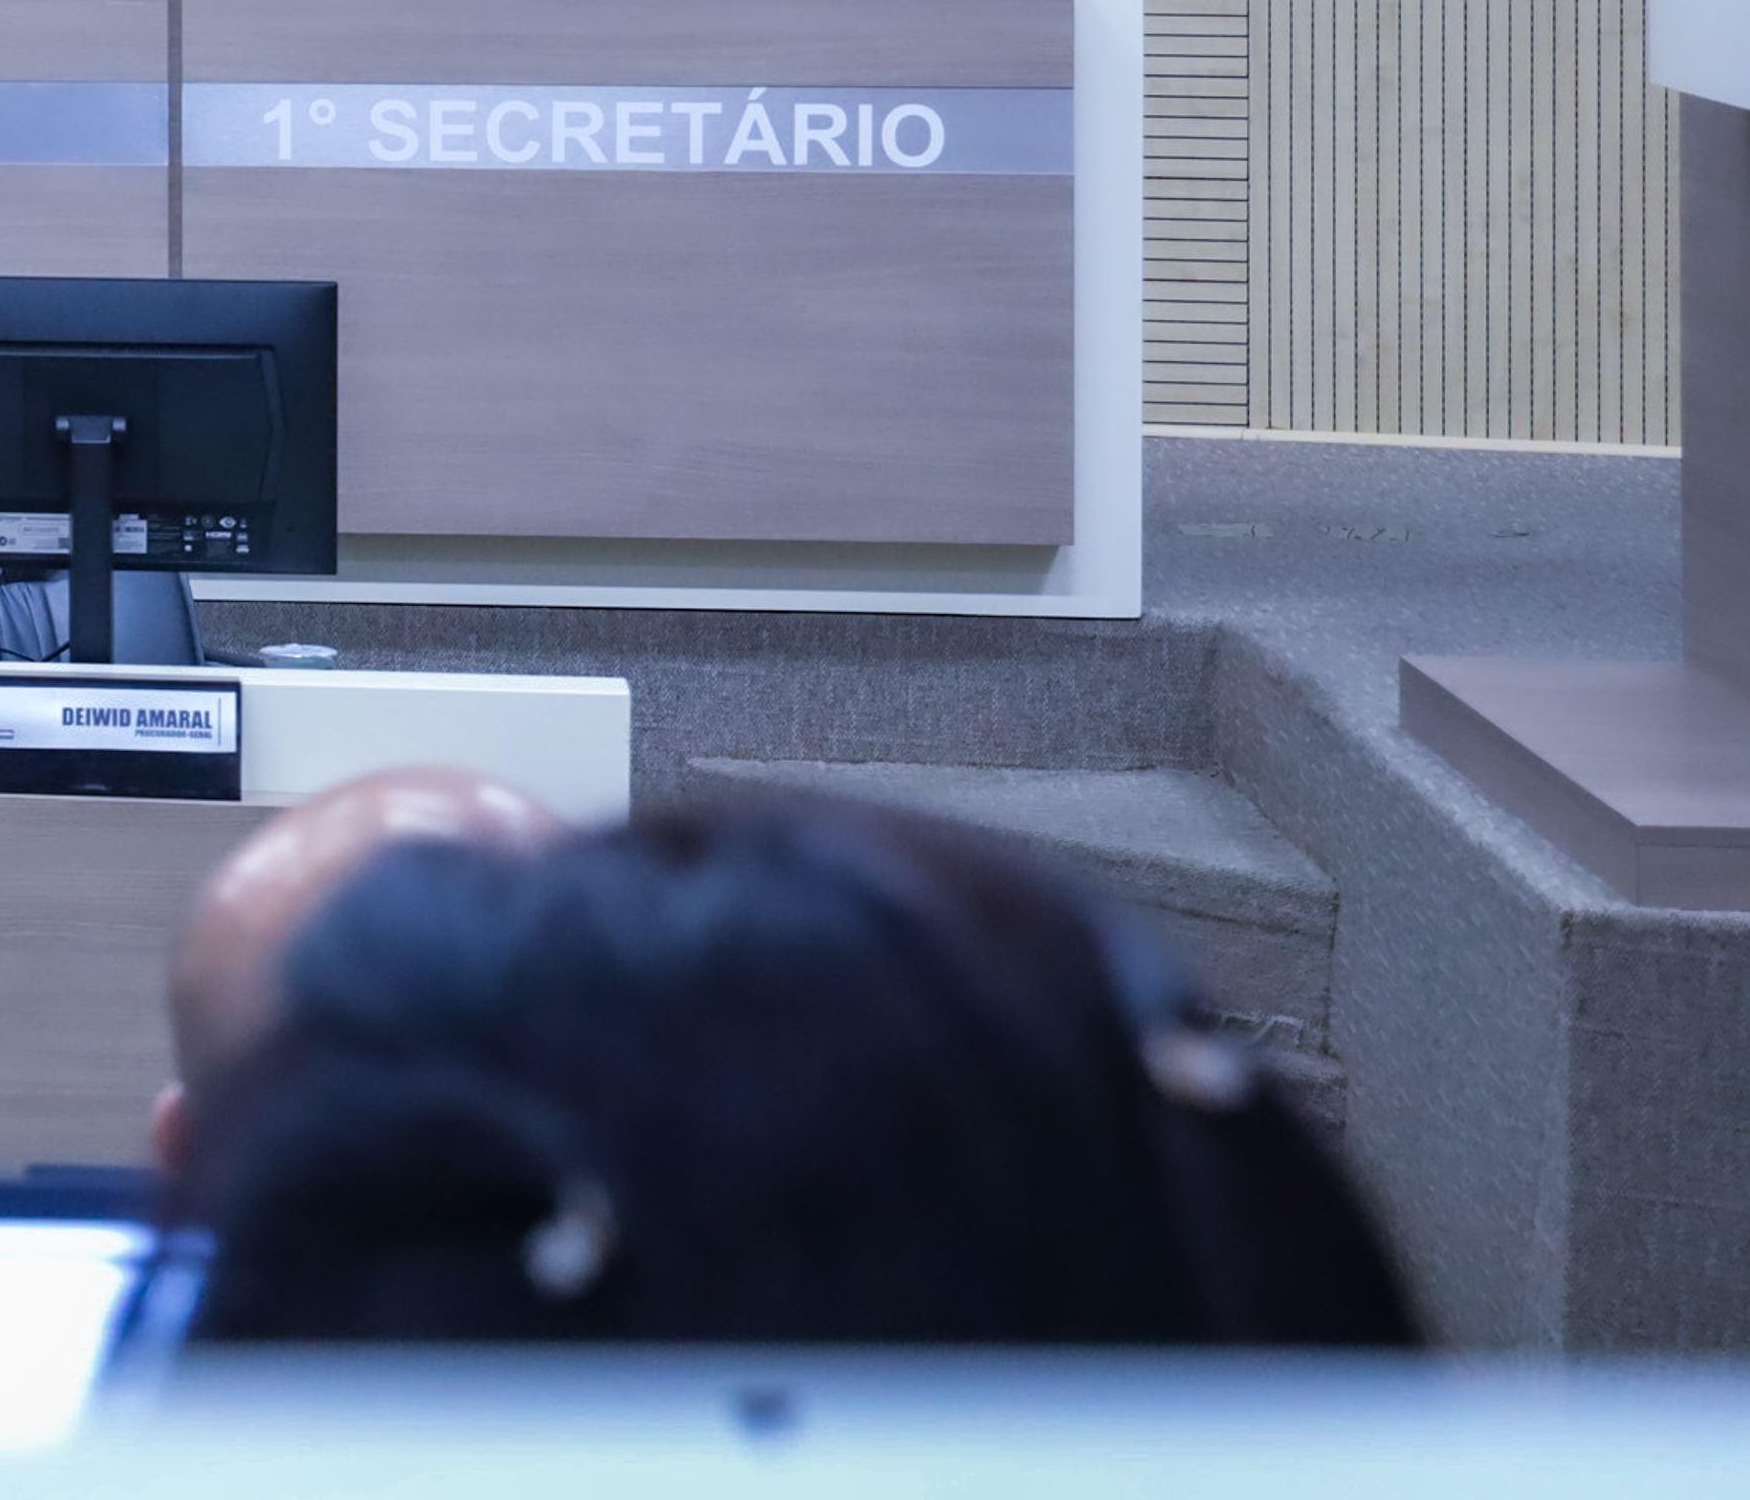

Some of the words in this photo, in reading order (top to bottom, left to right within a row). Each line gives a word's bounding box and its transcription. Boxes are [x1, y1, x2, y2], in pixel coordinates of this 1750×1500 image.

[368, 86, 945, 168] SECRETÁRIO
[62, 707, 132, 728] DEIWID
[135, 708, 213, 730] AMARAL
